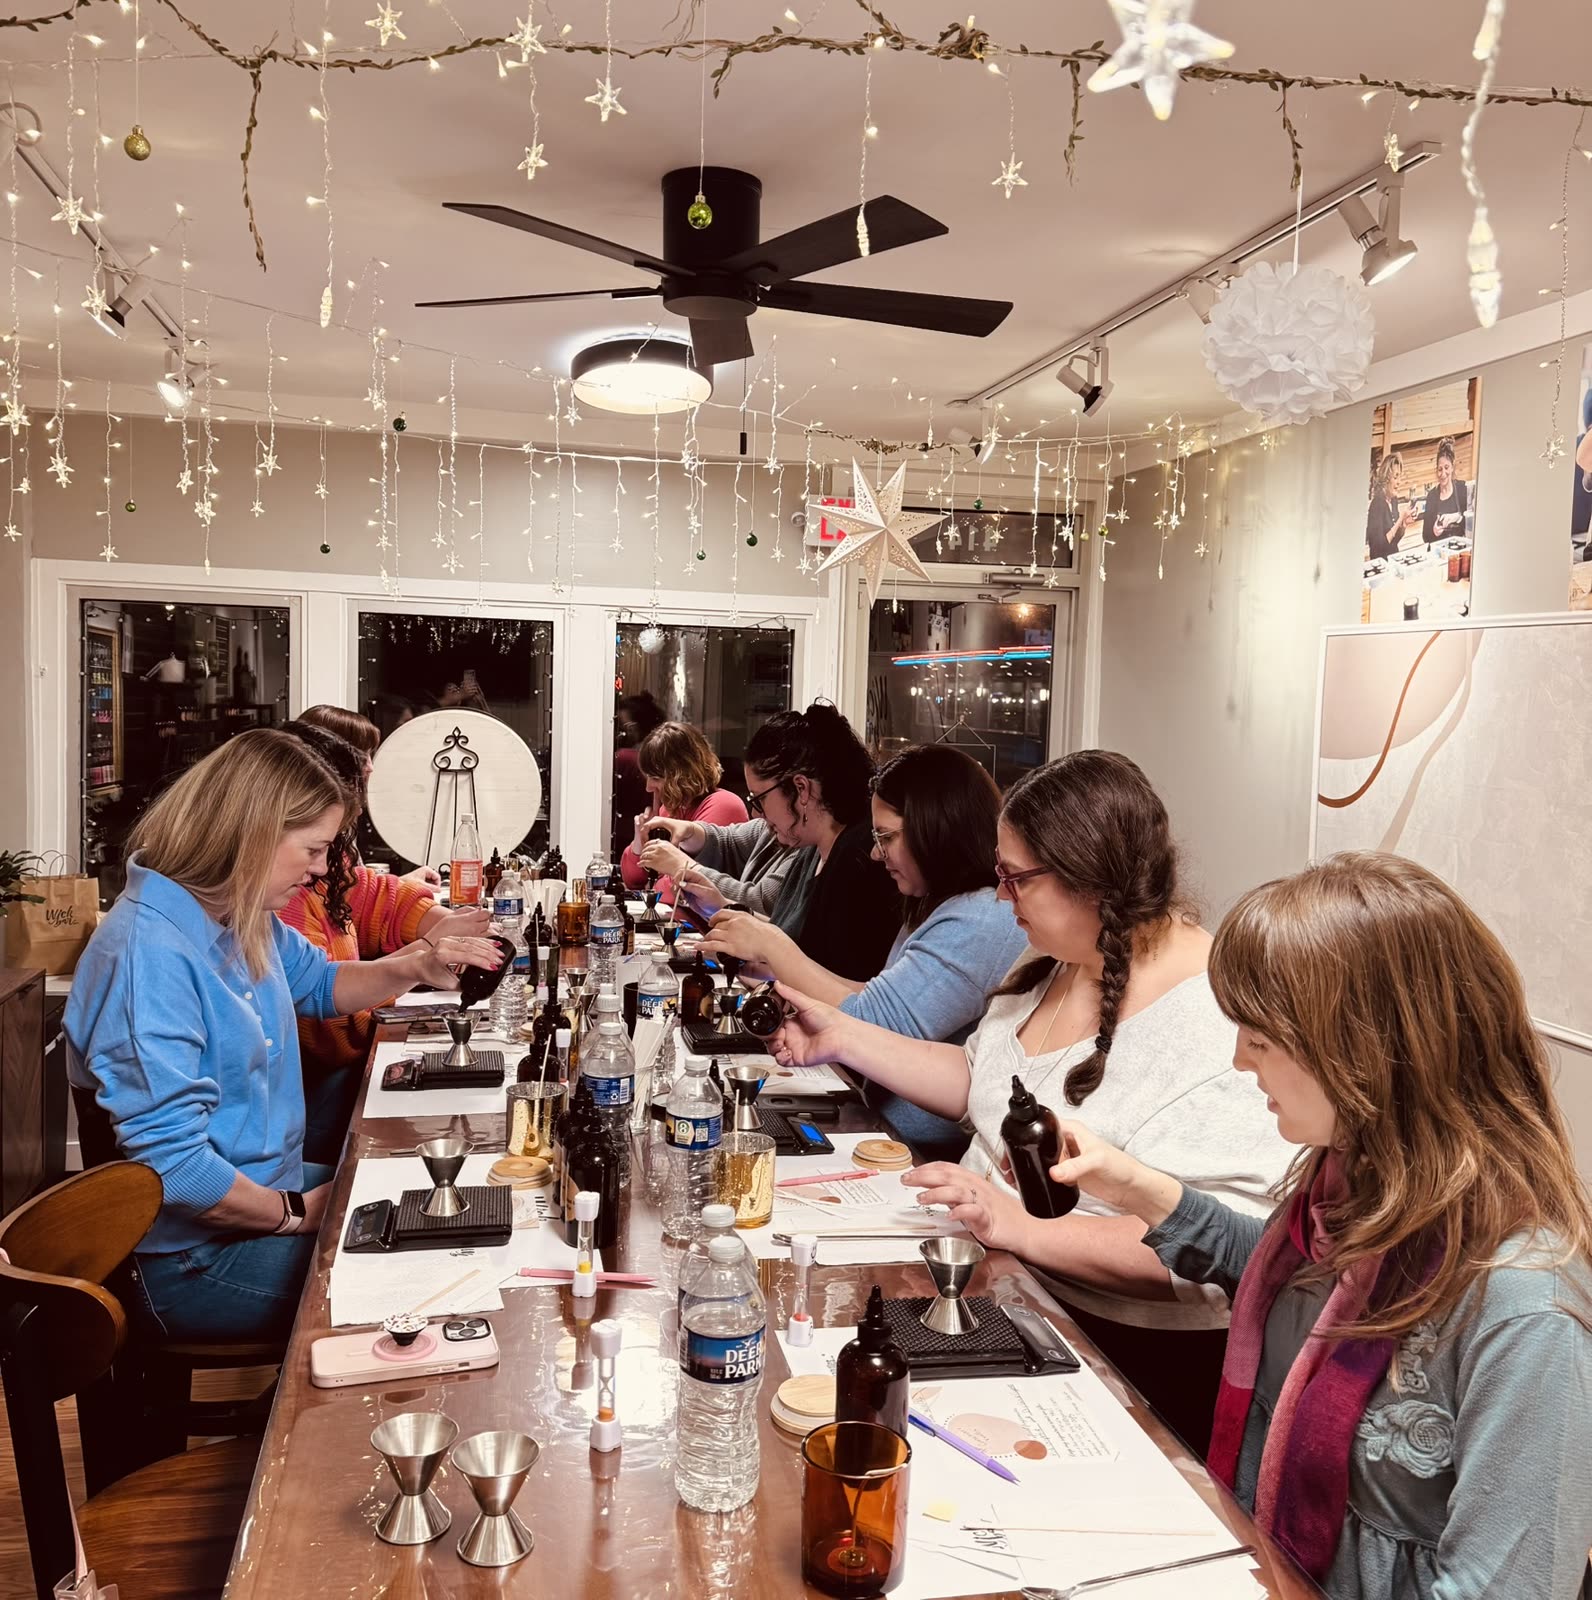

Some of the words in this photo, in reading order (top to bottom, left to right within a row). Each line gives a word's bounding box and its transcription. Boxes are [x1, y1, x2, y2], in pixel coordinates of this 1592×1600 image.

[46, 905, 73, 921] Wick
[725, 1341, 762, 1364] DEER
[724, 1356, 762, 1379] PARK
